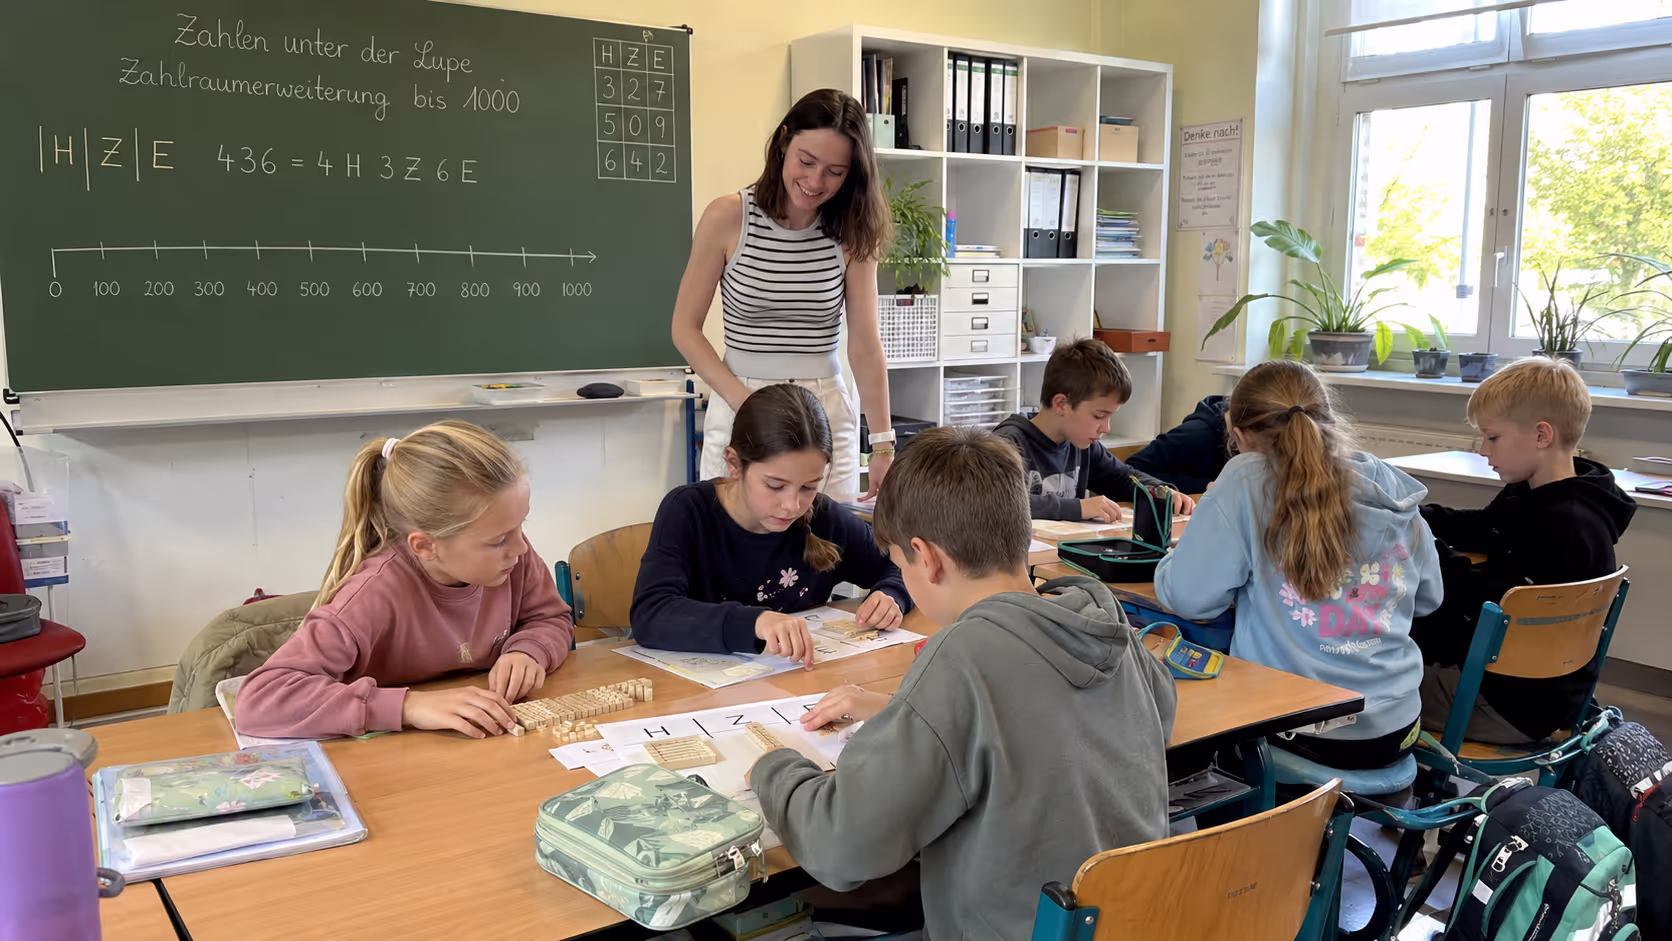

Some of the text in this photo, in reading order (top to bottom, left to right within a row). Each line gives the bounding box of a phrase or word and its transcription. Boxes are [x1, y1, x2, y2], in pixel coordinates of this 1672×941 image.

[175, 13, 472, 85] Zahlen unter der Lupe
[602, 45, 664, 69] H Z E
[119, 57, 519, 121] Zahlraumerweiterung bis 1000
[603, 76, 665, 101] 3 2 7
[604, 113, 664, 138] 5 0 9
[1184, 125, 1239, 141] Denke nach!
[54, 135, 174, 169] H Z E
[218, 144, 276, 174] 436
[318, 151, 333, 176] 4
[347, 153, 360, 177] H
[380, 156, 393, 179] 3
[404, 157, 421, 180] Z
[437, 159, 448, 181] 6
[462, 160, 477, 183] E
[605, 149, 667, 174] 6 4 2
[49, 281, 591, 297] 0 100 200 300 400 500 600 700 800 900 1000
[643, 714, 752, 738] H Z
